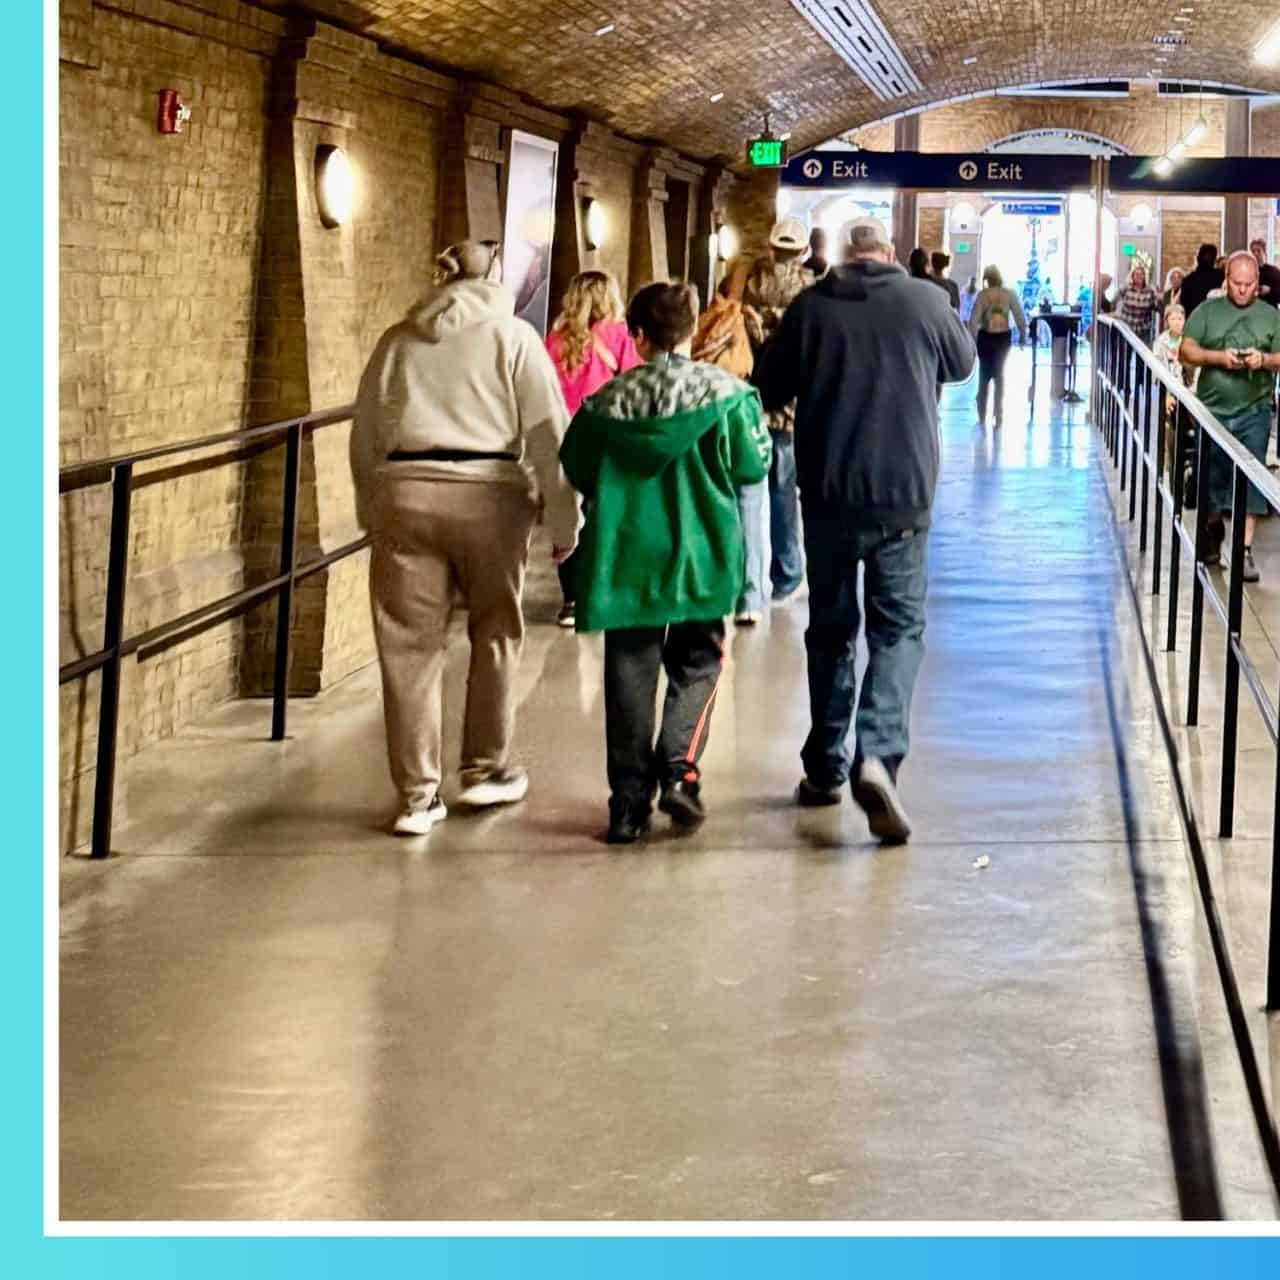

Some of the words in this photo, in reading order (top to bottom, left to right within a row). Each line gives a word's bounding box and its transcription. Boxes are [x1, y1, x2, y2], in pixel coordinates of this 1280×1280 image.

[753, 142, 782, 165] EXIT
[832, 160, 868, 177] Exit
[987, 162, 1023, 180] Exit
